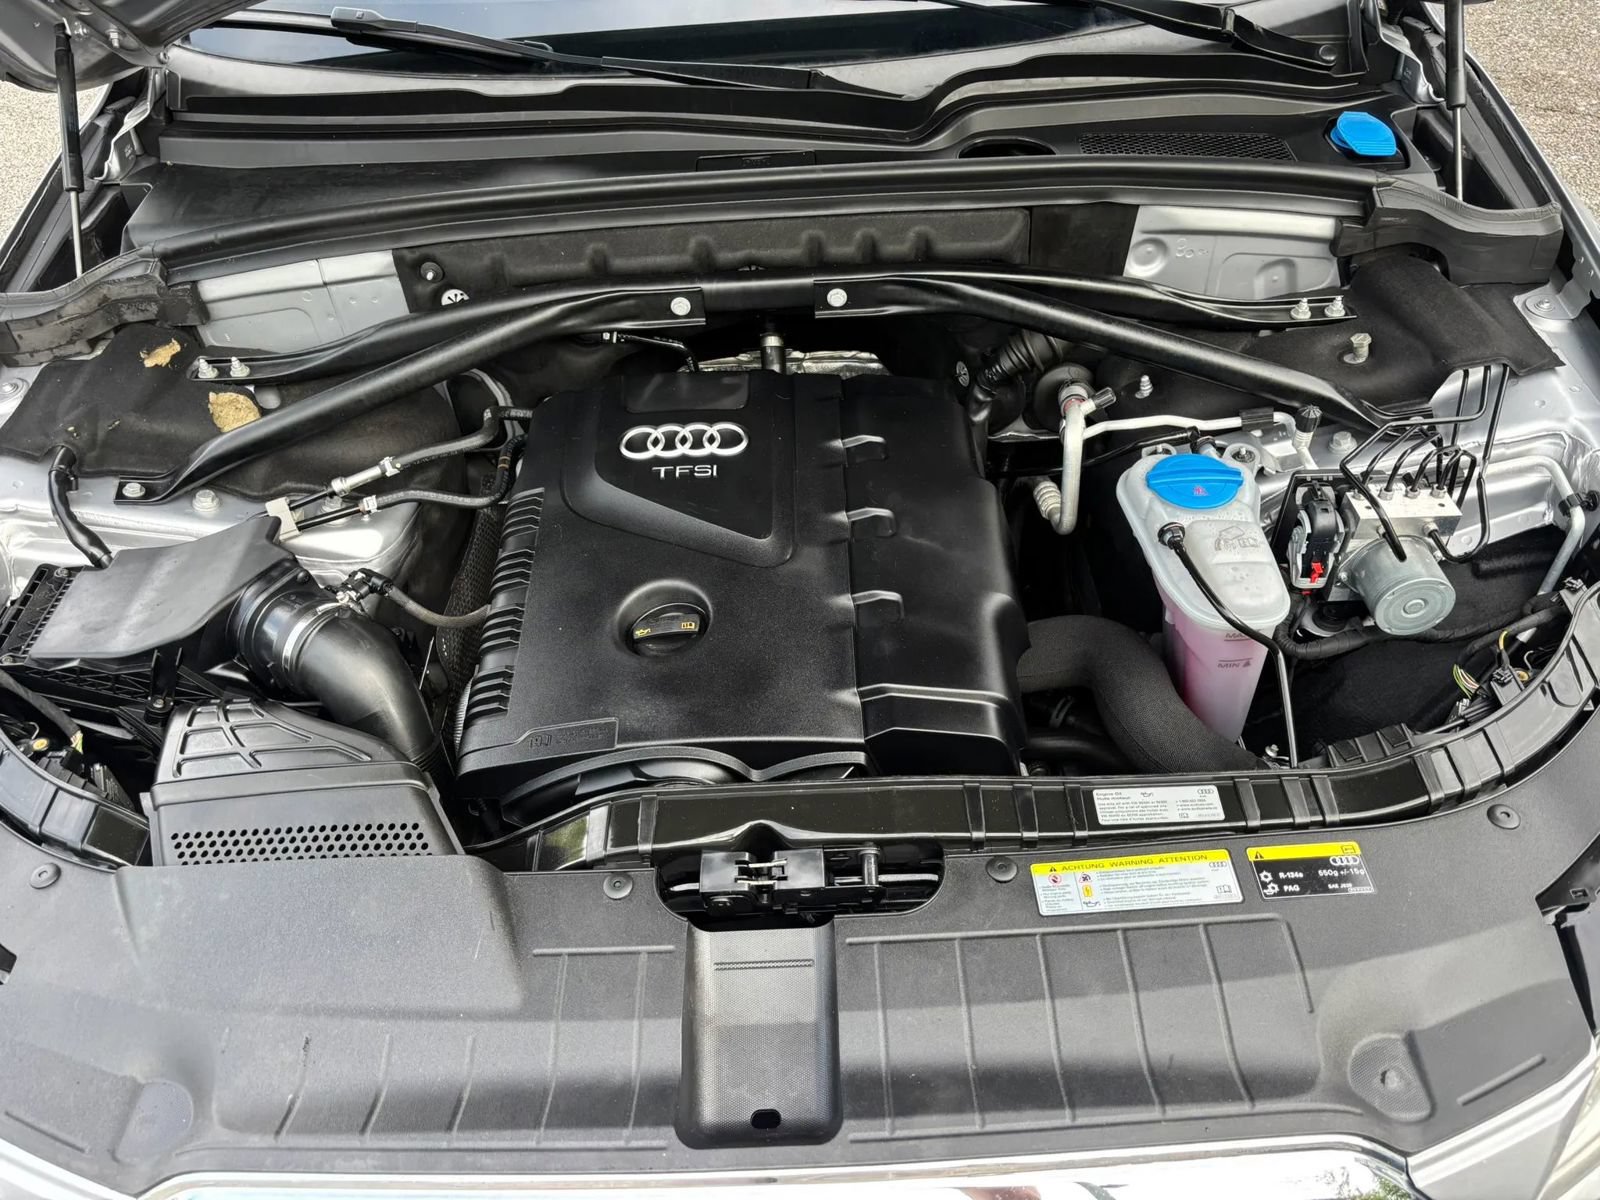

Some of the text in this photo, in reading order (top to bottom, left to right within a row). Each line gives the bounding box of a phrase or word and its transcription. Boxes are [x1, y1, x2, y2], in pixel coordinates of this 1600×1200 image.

[652, 464, 717, 479] TFSI
[1062, 854, 1208, 871] ACHTUNG WARNING ATTENTION
[1278, 871, 1304, 879] R-134a
[1283, 884, 1300, 892] PAG
